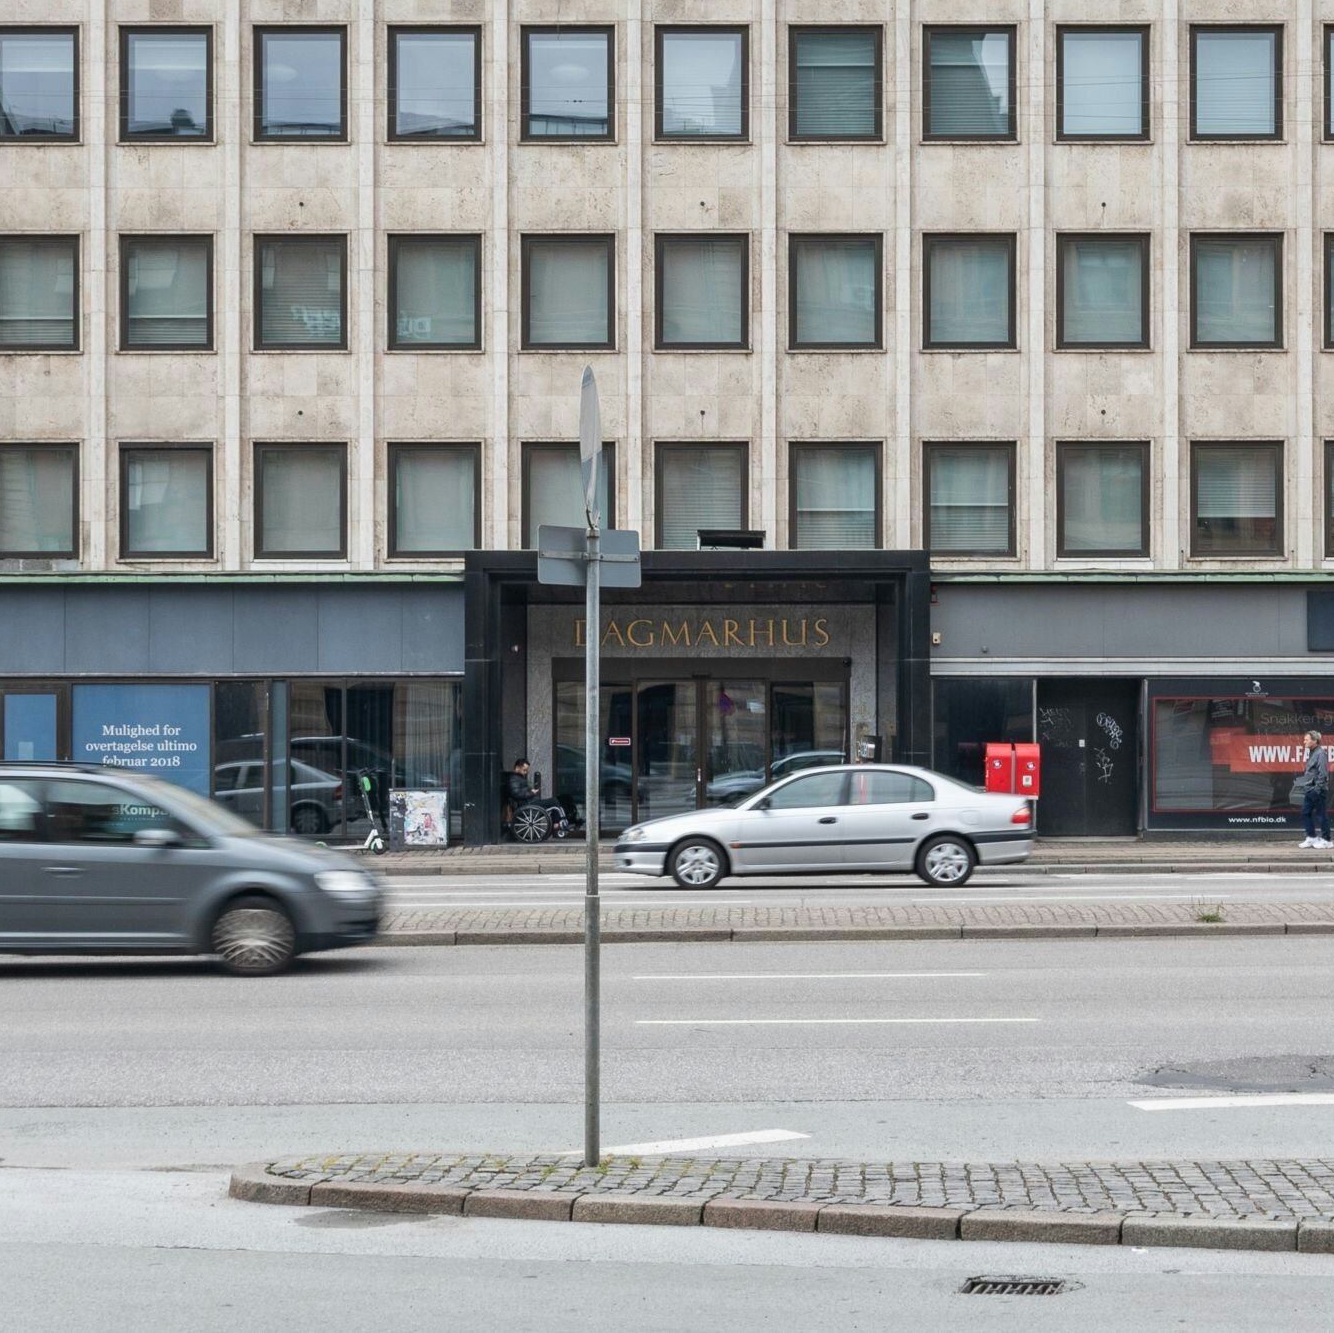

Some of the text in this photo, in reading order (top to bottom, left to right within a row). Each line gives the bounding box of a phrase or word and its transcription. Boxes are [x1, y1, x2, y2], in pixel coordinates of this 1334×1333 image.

[102, 724, 181, 738] Mulighed for
[85, 739, 197, 753] overtagelse ultimo
[102, 755, 181, 767] februar 2018
[1228, 816, 1287, 824] www.nfbio.dk
